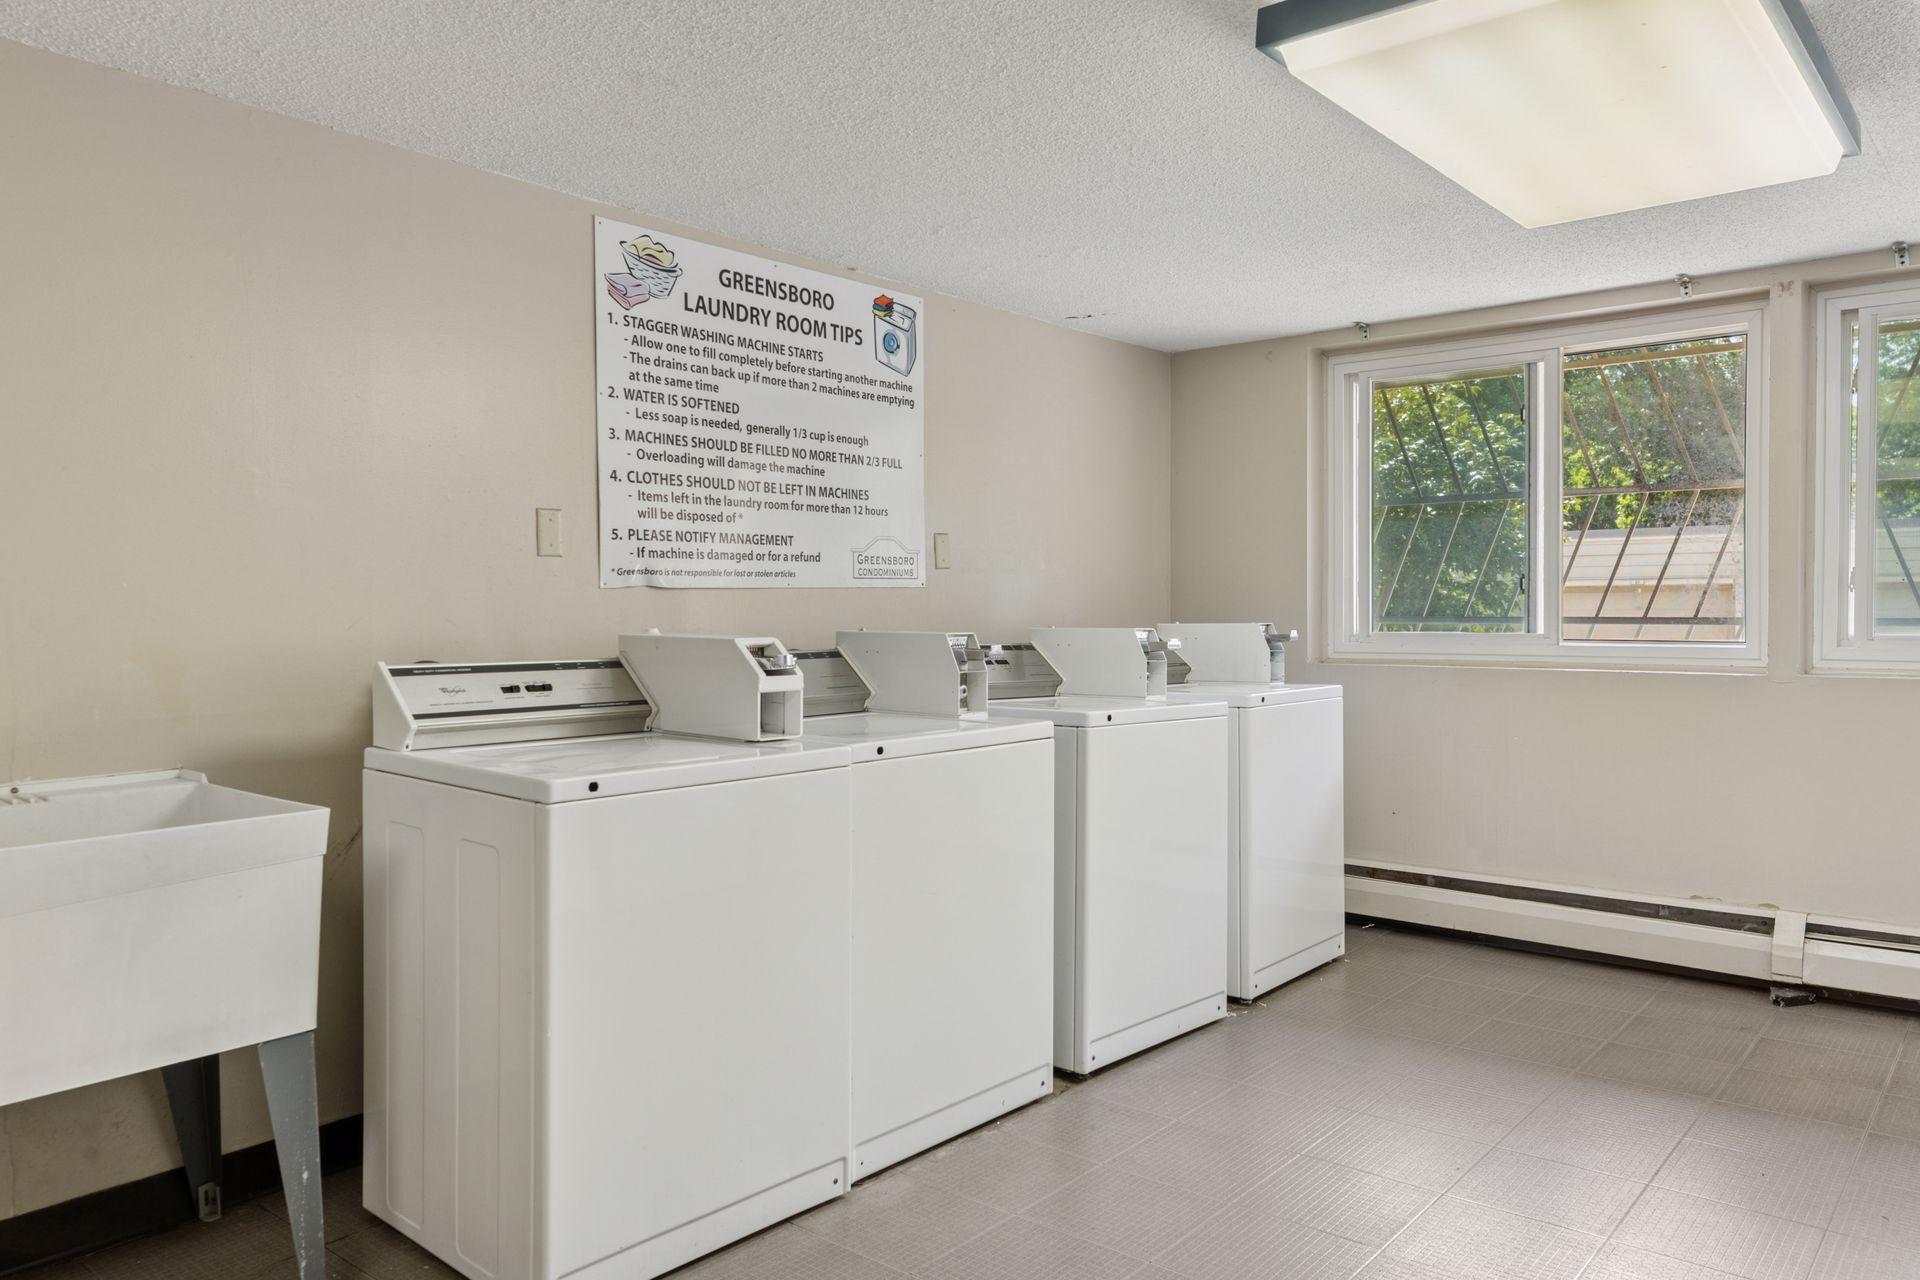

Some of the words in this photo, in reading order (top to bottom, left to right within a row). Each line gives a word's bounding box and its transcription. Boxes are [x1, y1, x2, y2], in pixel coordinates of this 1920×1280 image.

[719, 269, 834, 311] GREENSBORO
[684, 292, 771, 327] LAUNDRY
[776, 312, 827, 339] ROOM
[830, 323, 863, 346] TIPS
[608, 312, 618, 325] 1.
[623, 315, 678, 336] STAGGER
[680, 325, 734, 346] WASHING
[737, 336, 786, 355] MACHINE
[788, 346, 823, 362] STARTS
[631, 334, 663, 350] Allow
[666, 343, 687, 355] one
[689, 346, 700, 357] to
[702, 346, 716, 359] fill
[718, 352, 773, 372] completely
[775, 359, 806, 375] before
[808, 367, 843, 383] starting
[844, 374, 878, 386] another
[879, 380, 913, 393] machine
[629, 351, 651, 366] The
[653, 355, 688, 371] drains
[690, 364, 709, 375] can
[711, 364, 736, 379] back
[738, 372, 751, 384] up
[753, 371, 760, 383] if
[762, 376, 787, 387] more
[788, 378, 810, 391] than
[812, 382, 817, 392] 2
[819, 385, 860, 399] machines
[861, 392, 875, 401] are
[876, 394, 915, 409] emptying
[629, 371, 640, 382] at
[643, 371, 662, 384] the
[664, 377, 693, 390] same
[696, 379, 719, 393] time
[608, 386, 619, 399] 2.
[623, 388, 665, 405] WATER
[668, 394, 678, 406] IS
[681, 396, 740, 414] SOFTENED
[636, 407, 660, 421] Less
[662, 413, 688, 427] soap
[691, 414, 699, 426] is
[701, 418, 742, 432] needed,
[746, 424, 791, 439] generally
[793, 428, 807, 439] 1/3
[809, 432, 826, 443] cup
[827, 431, 835, 442] is
[836, 435, 869, 448] enough
[609, 427, 620, 440] 3.
[625, 429, 688, 447] MACHINES
[691, 436, 738, 452] SHOULD
[740, 442, 753, 454] BE
[756, 443, 790, 457] FILLED
[792, 447, 807, 460] NO
[809, 449, 837, 463] MORE
[838, 452, 864, 465] THAN
[866, 456, 880, 467] 2/3
[882, 457, 903, 469] FULL
[636, 448, 704, 468] Overloading
[707, 455, 725, 467] will
[727, 457, 767, 474] damage
[769, 461, 785, 473] the
[787, 464, 825, 477] machine
[610, 469, 622, 482] 4.
[627, 470, 683, 487] CLOTHES
[686, 475, 735, 490] SHOULD
[738, 480, 761, 492] NOT
[764, 481, 776, 494] BE
[779, 483, 803, 496] LEFT
[806, 485, 816, 497] IN
[819, 486, 869, 501] MACHINES
[637, 507, 657, 519] will
[660, 508, 674, 520] be
[676, 509, 723, 524] disposed
[725, 512, 737, 523] of
[638, 489, 668, 503] Items
[671, 491, 689, 504] left
[692, 493, 702, 505] in
[704, 494, 721, 506] the
[724, 495, 762, 511] laundry
[764, 501, 789, 510] room
[791, 500, 804, 511] for
[806, 504, 829, 513] more
[831, 503, 851, 514] than
[853, 505, 863, 515] 12
[865, 505, 888, 517] hours
[611, 528, 623, 540] 5.
[628, 528, 673, 542] PLEASE
[675, 530, 716, 543] NOTIFY
[719, 532, 794, 546] MANAGEMENT
[637, 546, 646, 558] If
[648, 547, 694, 560] machine
[696, 548, 705, 560] is
[707, 548, 754, 564] damaged
[755, 553, 766, 561] or
[768, 550, 781, 562] for
[783, 554, 788, 562] a
[791, 551, 821, 562] refund
[857, 554, 914, 566] GREENSBORO
[616, 567, 663, 576] Greensboro
[684, 569, 722, 578] responsible
[723, 569, 733, 577] for
[734, 569, 746, 577] lost
[754, 570, 773, 578] stolen
[774, 570, 796, 578] articles
[857, 567, 914, 577] CONDOMINIUMS
